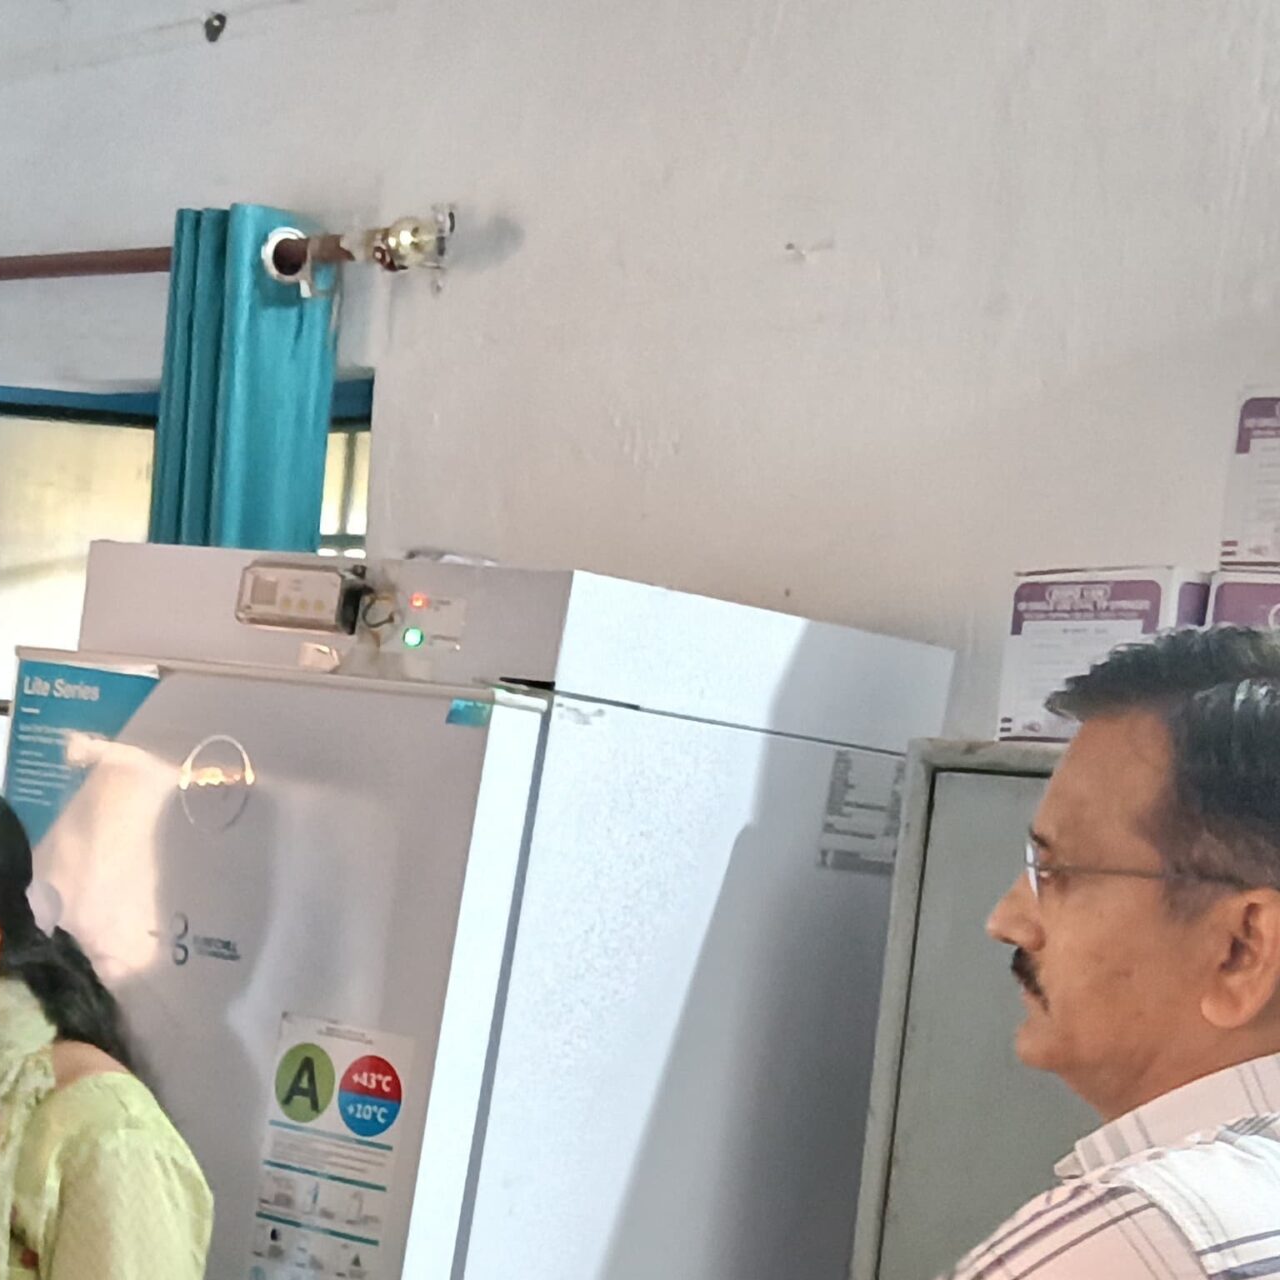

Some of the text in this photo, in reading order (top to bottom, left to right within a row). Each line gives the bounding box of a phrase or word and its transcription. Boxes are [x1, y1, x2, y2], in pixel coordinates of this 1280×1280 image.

[23, 676, 101, 701] Lite Series
[282, 1055, 321, 1114] A
[351, 1071, 393, 1092] +43°C
